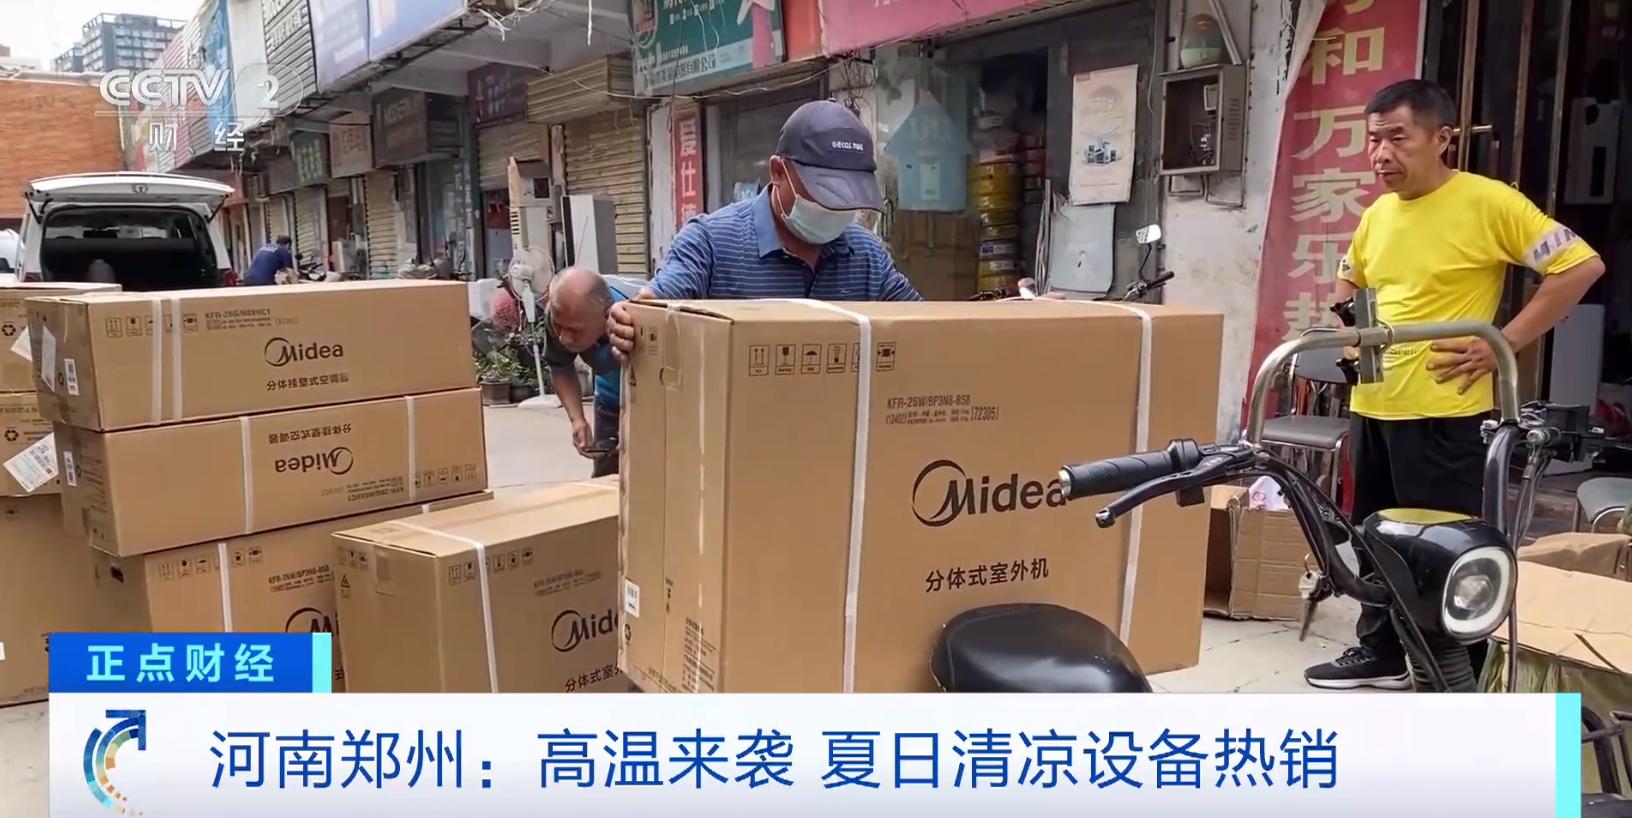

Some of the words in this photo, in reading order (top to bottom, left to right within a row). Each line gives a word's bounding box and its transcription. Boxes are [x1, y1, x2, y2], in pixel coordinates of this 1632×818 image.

[264, 337, 344, 367] Midea
[275, 446, 354, 475] Midea
[912, 459, 1067, 527] Midea
[925, 558, 1049, 592] 分体式室外机
[551, 609, 618, 652] Mid
